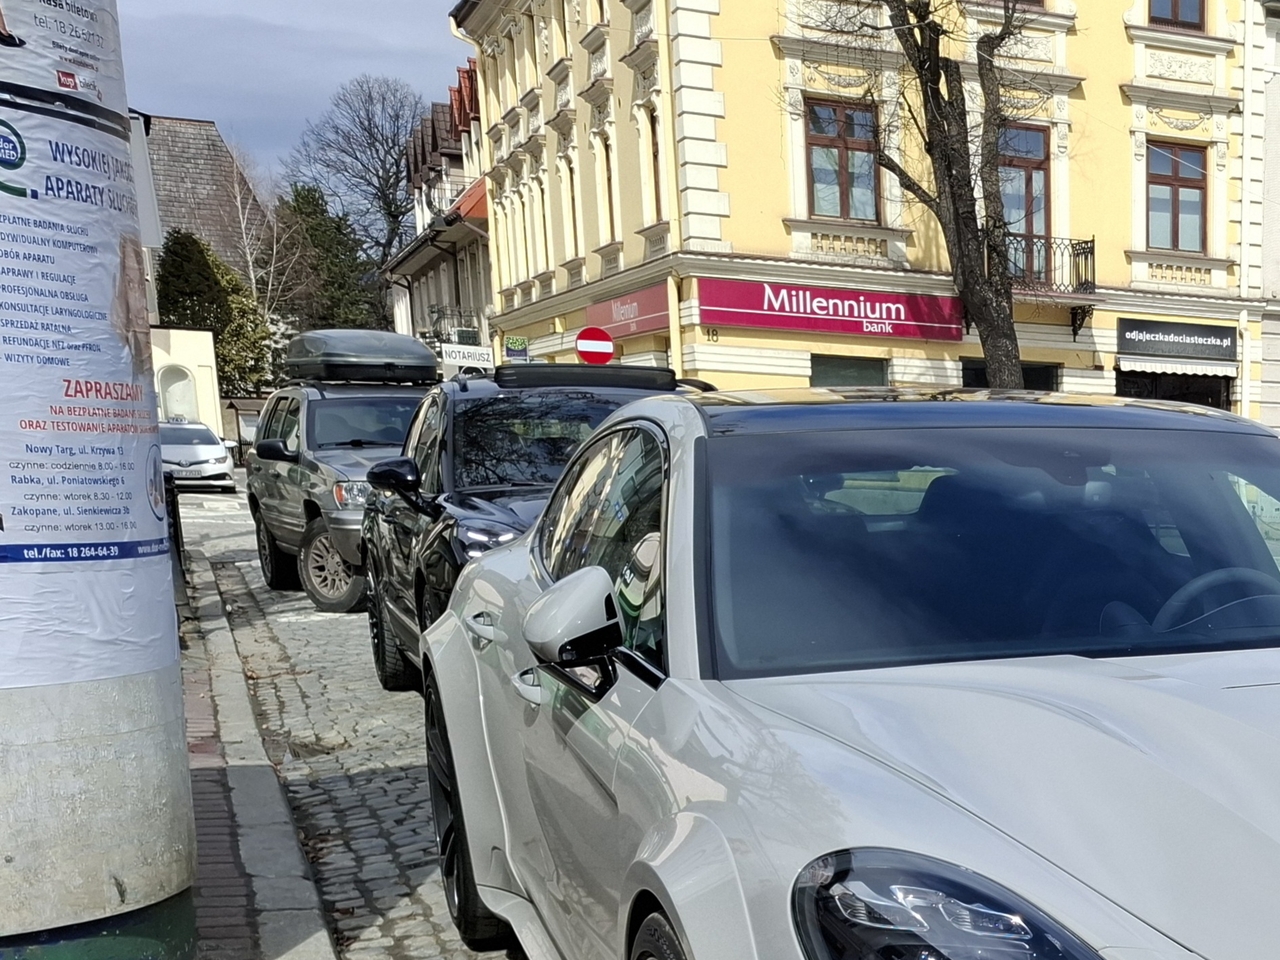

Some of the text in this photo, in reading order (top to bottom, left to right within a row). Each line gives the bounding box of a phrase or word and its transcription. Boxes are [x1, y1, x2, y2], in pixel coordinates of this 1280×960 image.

[34, 13, 51, 30] tel.
[54, 20, 66, 34] 18
[59, 72, 75, 89] kup
[48, 140, 111, 180] WYSOKIEJ
[45, 175, 104, 207] APARATY
[33, 219, 65, 233] BADANIA
[66, 225, 89, 237] SŁUCHU
[52, 239, 98, 254] KOMPUTEROWY
[22, 252, 55, 264] APARATU
[41, 271, 77, 286] REGULACJE
[60, 290, 89, 302] OBSŁUGA
[763, 284, 905, 320] Millennium
[51, 307, 108, 321] LARYNGOLOGICZNE
[0, 319, 72, 333] SPRZEDAŻ RATALNA
[863, 320, 893, 334] bank
[706, 328, 719, 343] 18
[2, 335, 50, 350] REFUNDACJE
[52, 341, 66, 350] NFZ
[81, 343, 102, 352] PFRON
[4, 353, 70, 366] WIZYTY DOMOWE
[444, 349, 491, 363] NOTARIUSZ
[63, 379, 144, 402] ZAPRASZAMY
[50, 405, 64, 416] NA
[67, 406, 111, 419] BEZPŁATNE
[19, 419, 48, 431] ORAZ
[50, 421, 106, 433] TESTOWANIE
[25, 443, 124, 458] Nowy Targ, ul. Krzywa 13
[9, 460, 48, 471] czynne:
[50, 460, 96, 471] codziennie
[97, 461, 114, 471] 8.00
[11, 475, 44, 487] Rabka,
[47, 476, 59, 485] ul.
[61, 476, 120, 487] Poniatowskiego
[23, 492, 133, 502] czynne: wtorek 8.30 12.00
[11, 506, 61, 518] Zakopane,
[63, 506, 75, 516] ul.
[76, 506, 122, 516] Sienkiewicza
[24, 524, 62, 533] czynne:
[64, 522, 92, 531] wtorek
[95, 522, 115, 531] 13.00
[23, 547, 65, 559] tel./fax:
[67, 547, 79, 557] 18
[80, 546, 119, 557] 264-64-39
